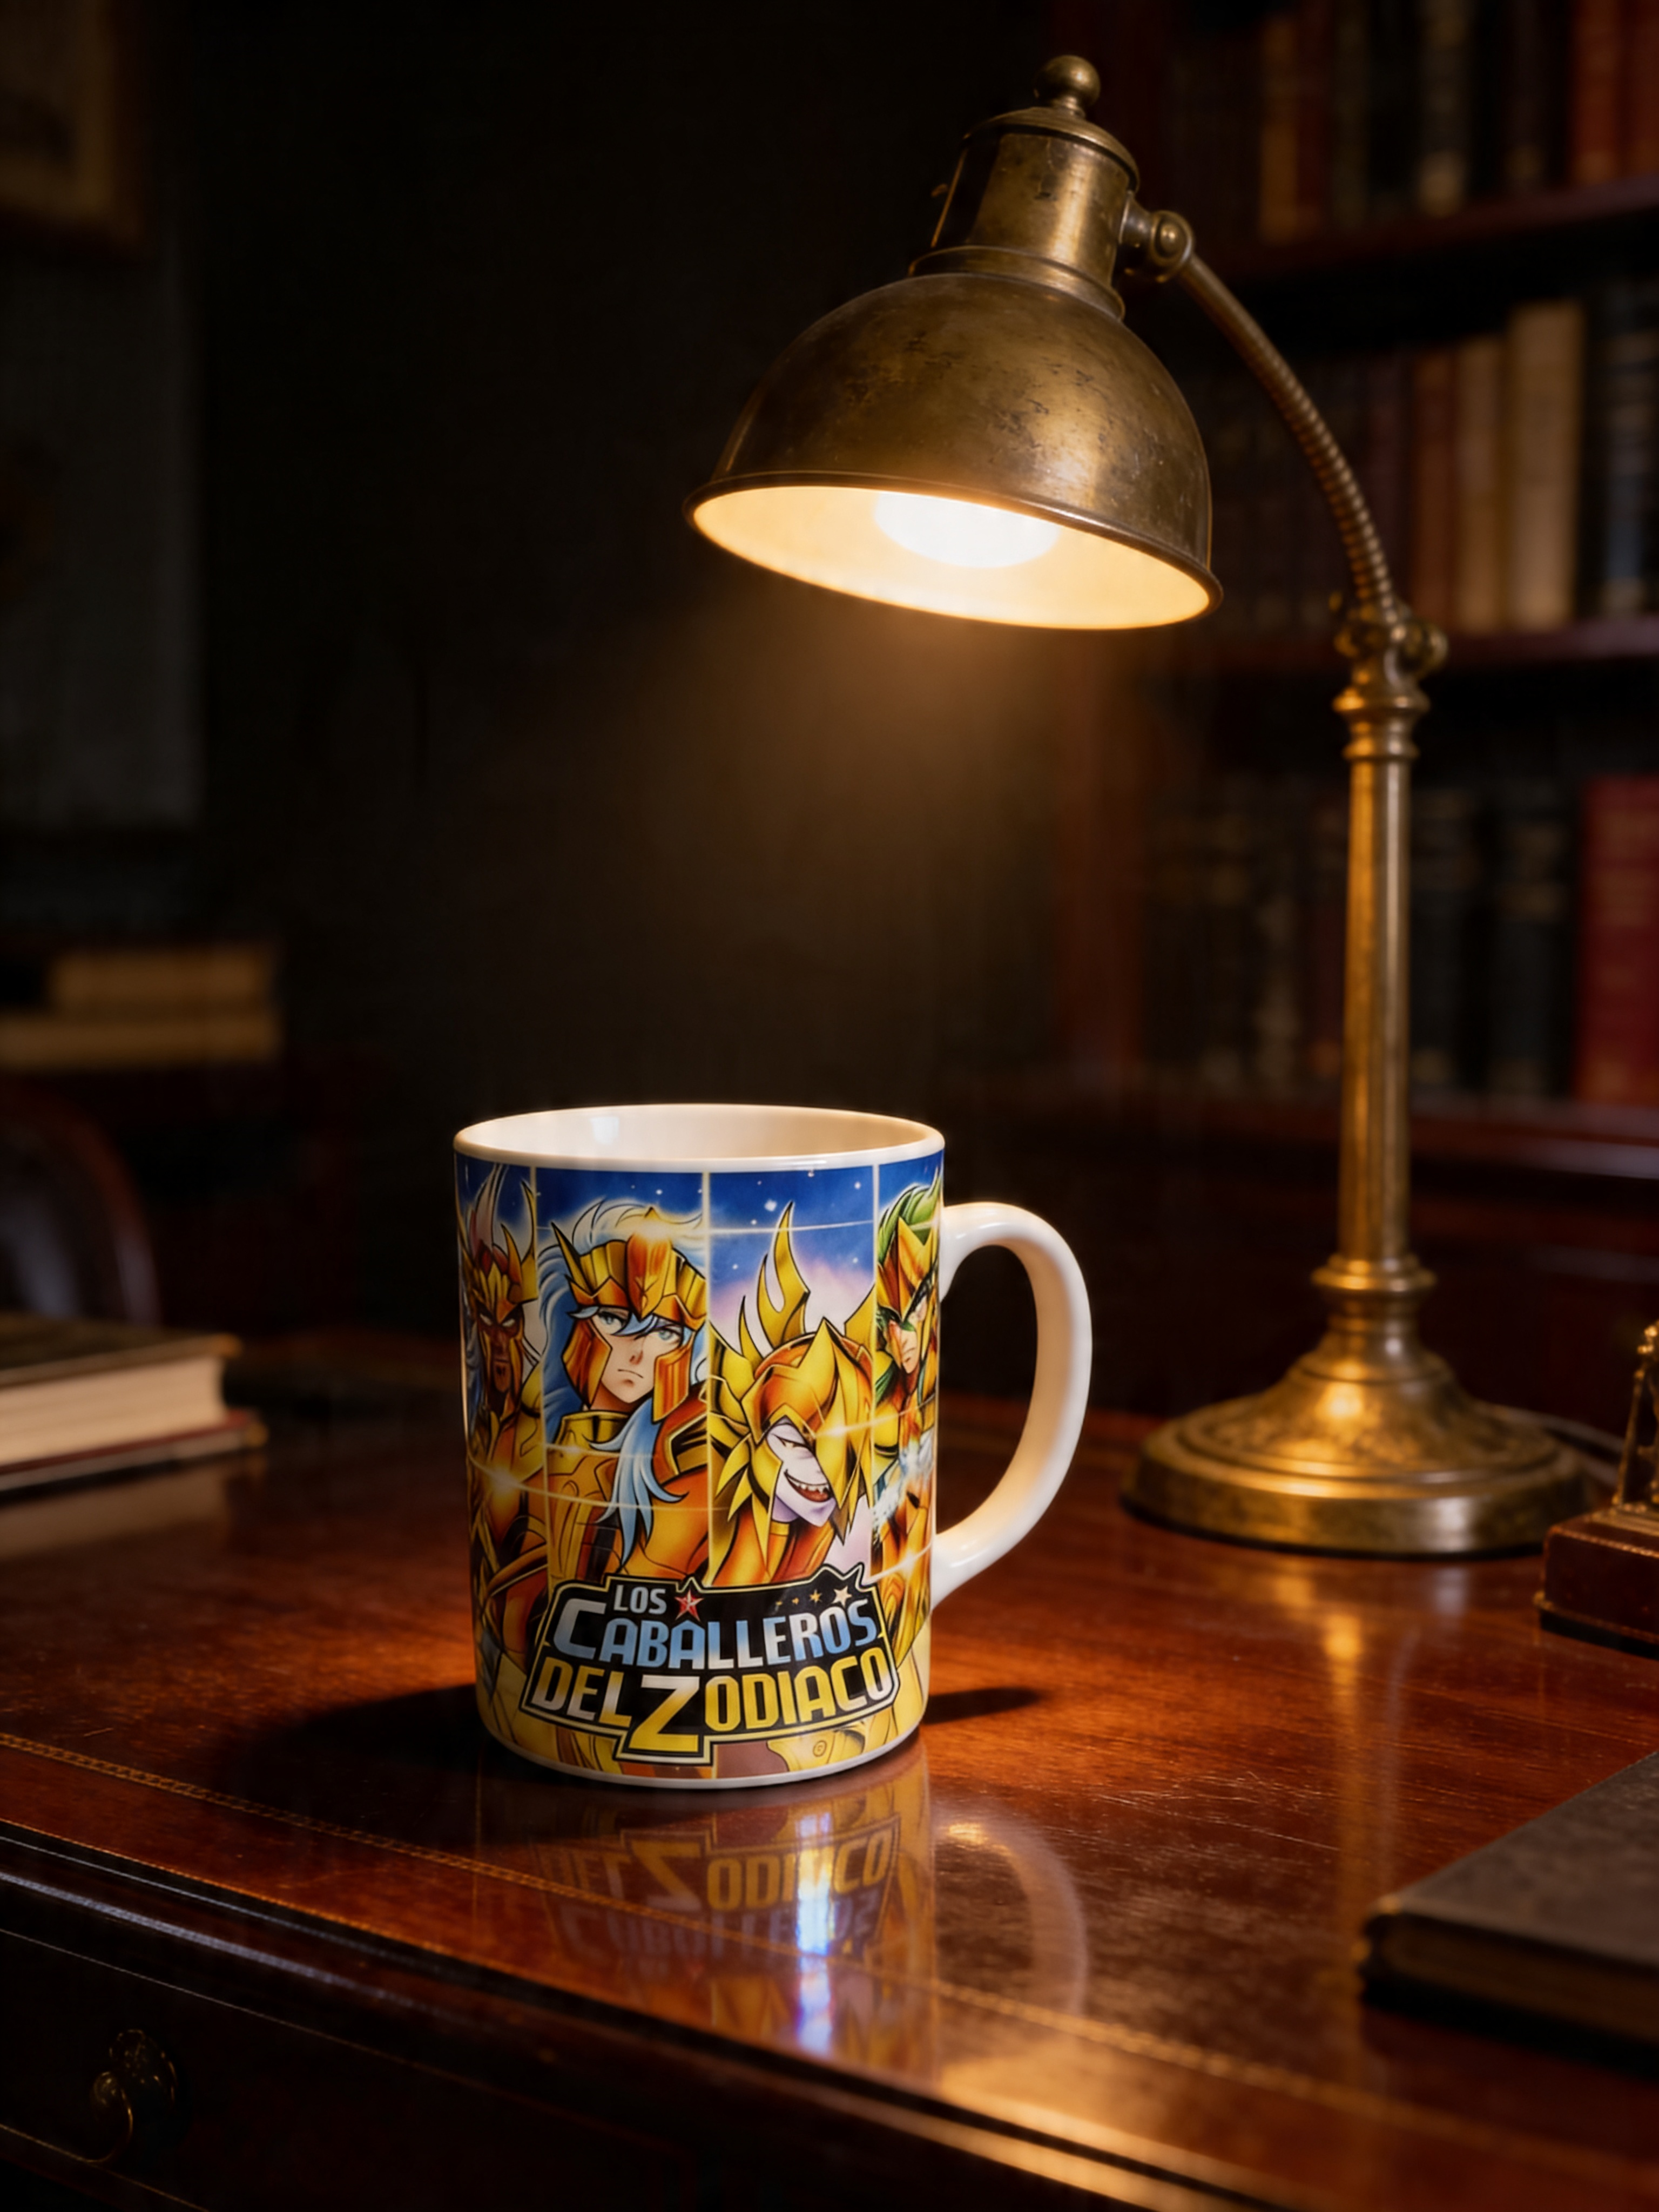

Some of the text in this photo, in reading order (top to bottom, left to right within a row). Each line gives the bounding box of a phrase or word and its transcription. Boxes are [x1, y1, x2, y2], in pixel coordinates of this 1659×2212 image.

[553, 1597, 878, 1670] CABALLEROS
[613, 1584, 667, 1615] LOS
[531, 1647, 893, 1752] DEL ZODIACO
